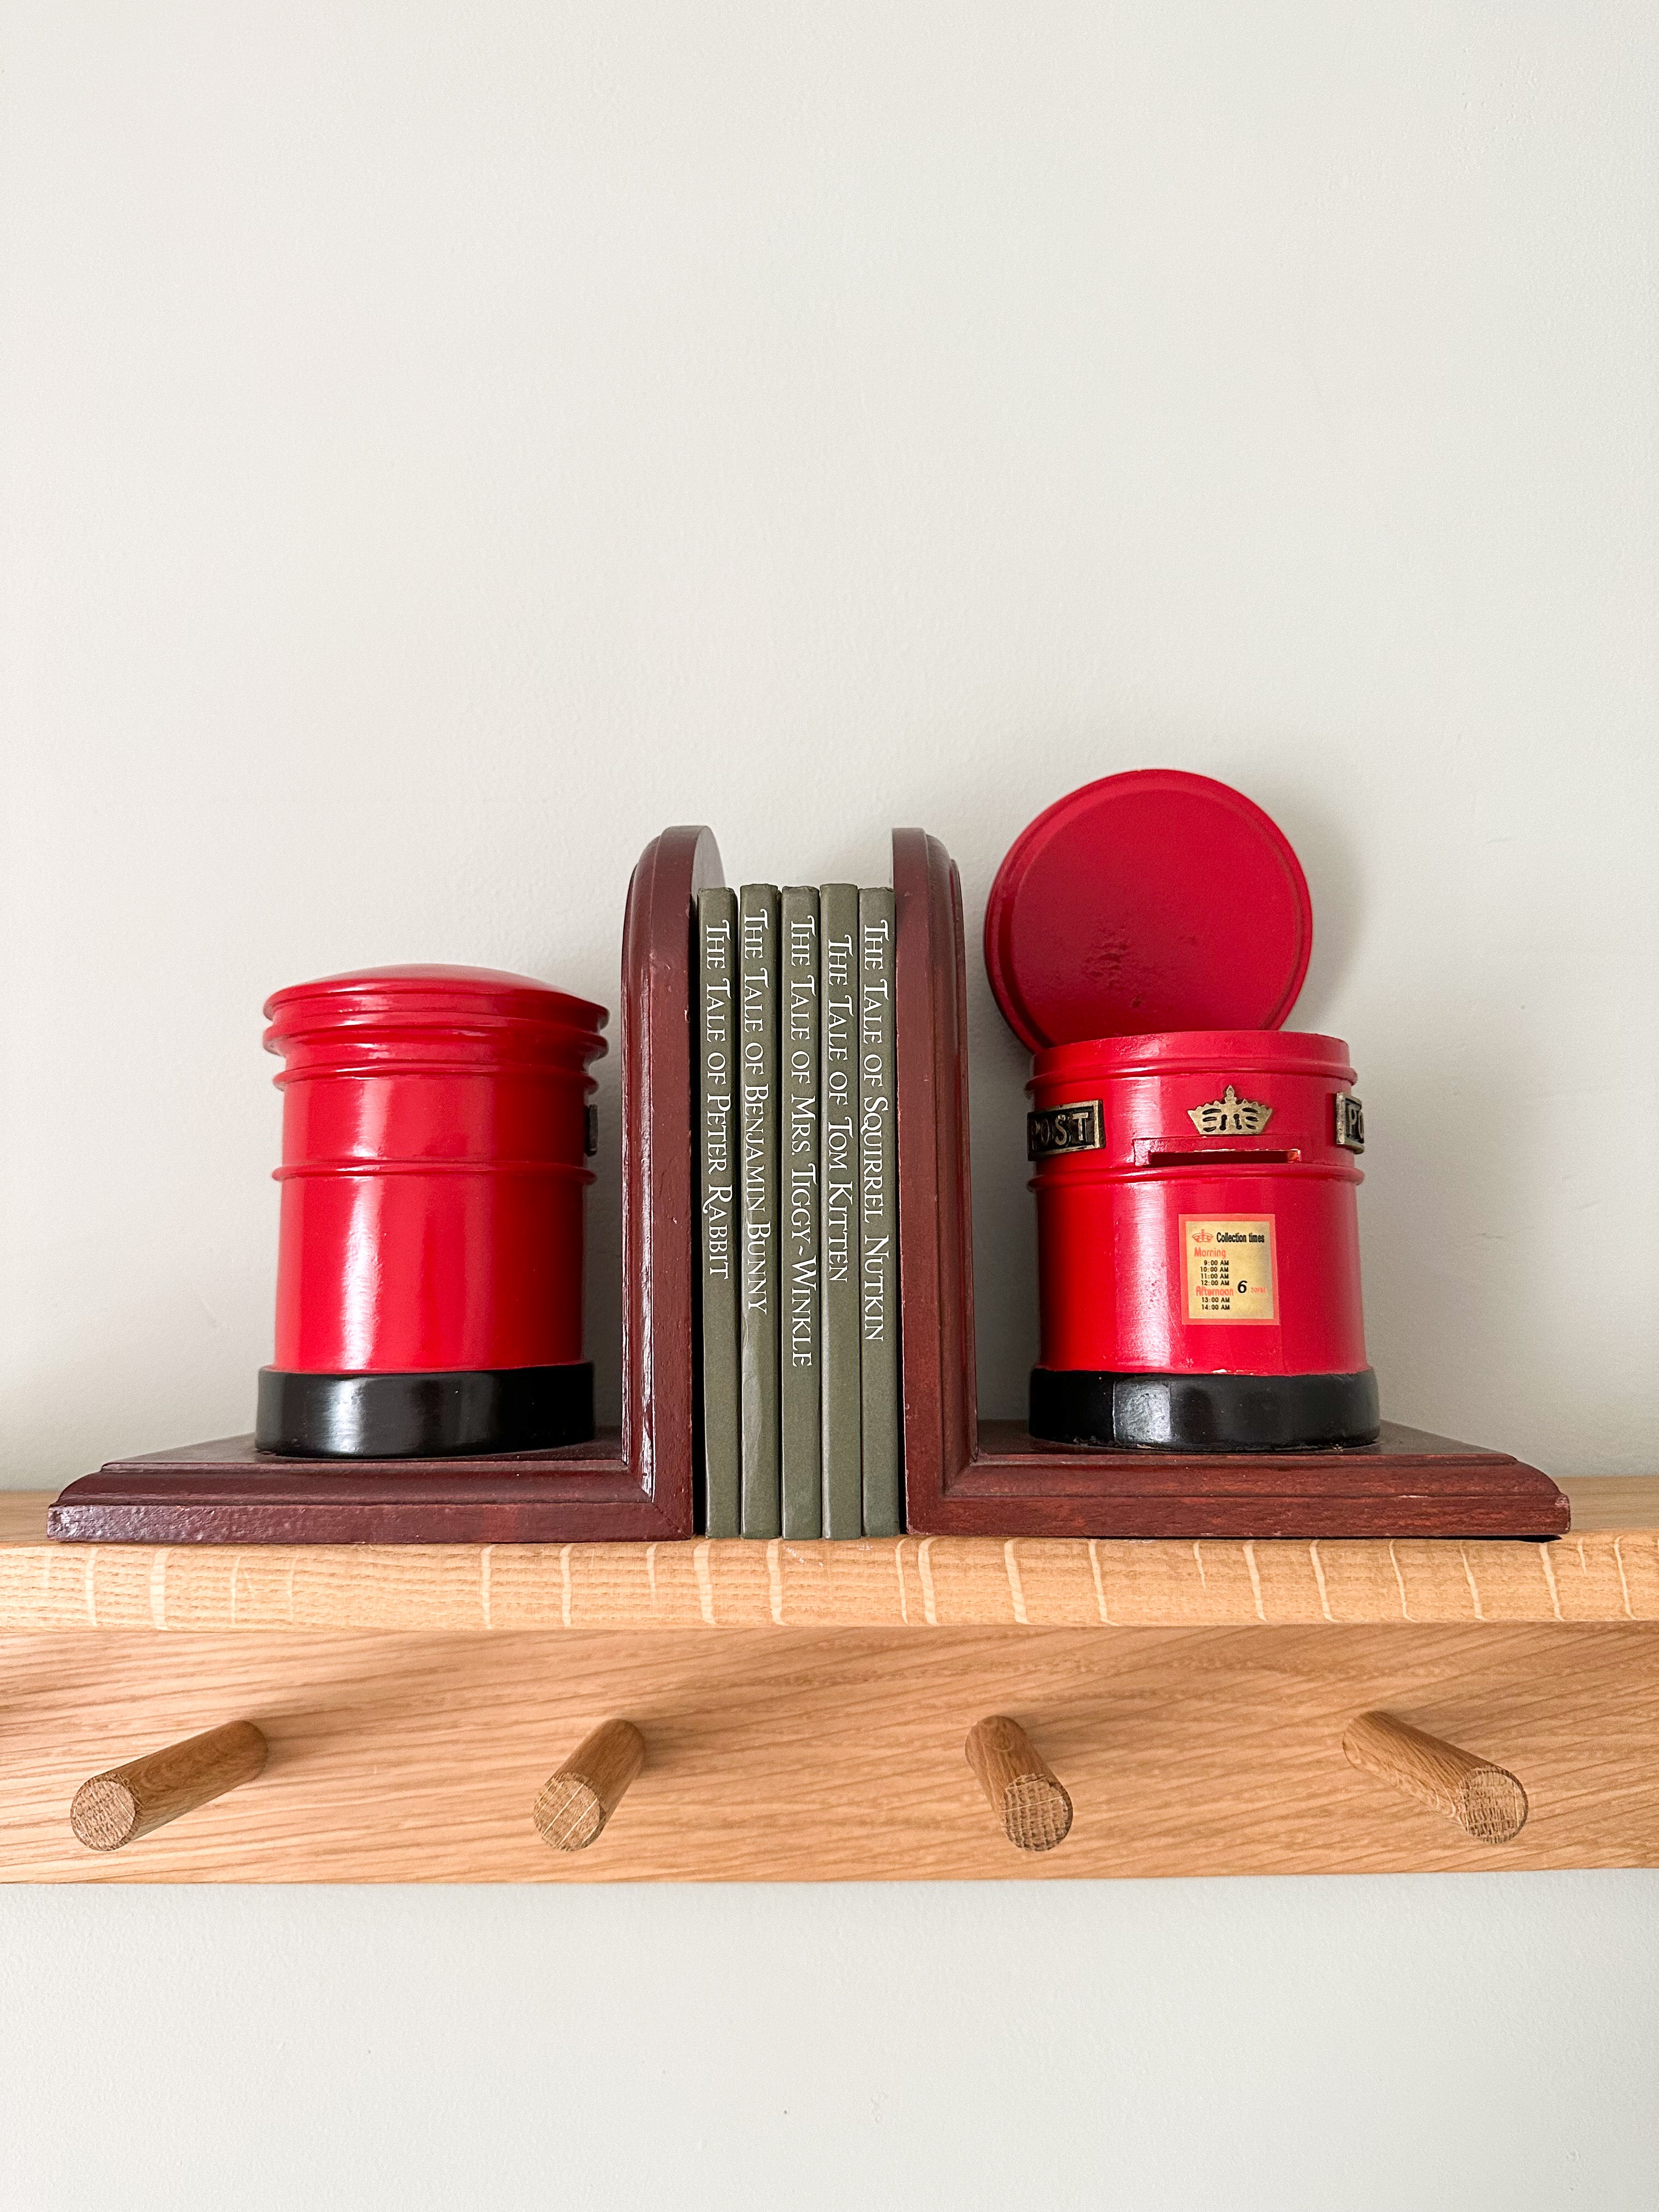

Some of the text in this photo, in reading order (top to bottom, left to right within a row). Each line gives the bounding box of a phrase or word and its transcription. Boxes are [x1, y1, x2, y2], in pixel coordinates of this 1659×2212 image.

[791, 915, 815, 967] THE
[791, 974, 816, 1041] TALE
[702, 919, 732, 1279] THE TALE OF PETER RABBIT
[791, 1051, 810, 1084] OF
[744, 909, 771, 1315] THE TALE OF BENJAMIN BUNNY
[791, 1093, 816, 1155] MRS.
[828, 934, 854, 1283] THE TALE OF TOM KITTEN
[860, 919, 889, 1341] THE TALE OF SQUIRREL NUTKIN
[1194, 1247, 1226, 1259] Morning
[1216, 1232, 1265, 1243] Collection times
